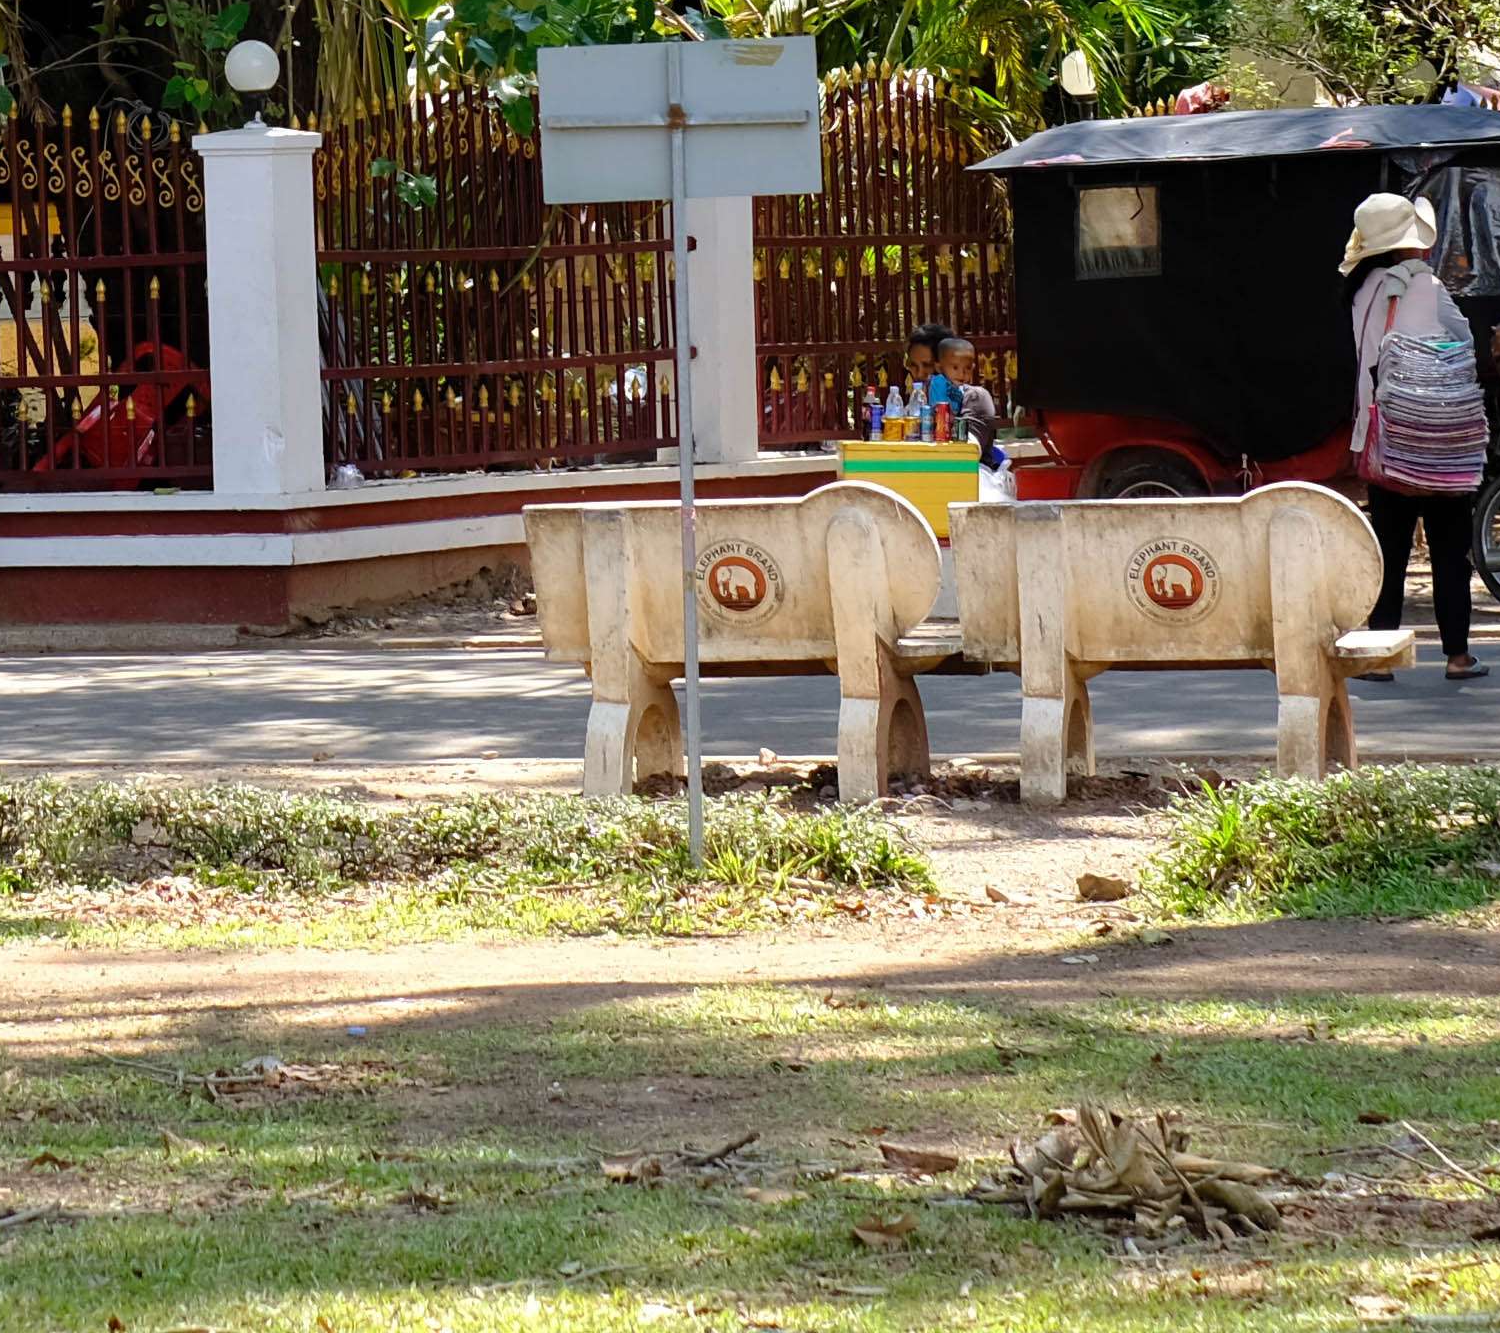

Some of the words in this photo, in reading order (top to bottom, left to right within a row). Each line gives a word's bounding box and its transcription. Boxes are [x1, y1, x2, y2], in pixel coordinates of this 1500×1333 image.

[696, 544, 742, 580] ELEPHANT
[745, 547, 778, 581] BRAND
[1129, 541, 1177, 579] ELEPHANT
[1182, 544, 1215, 578] BRAND
